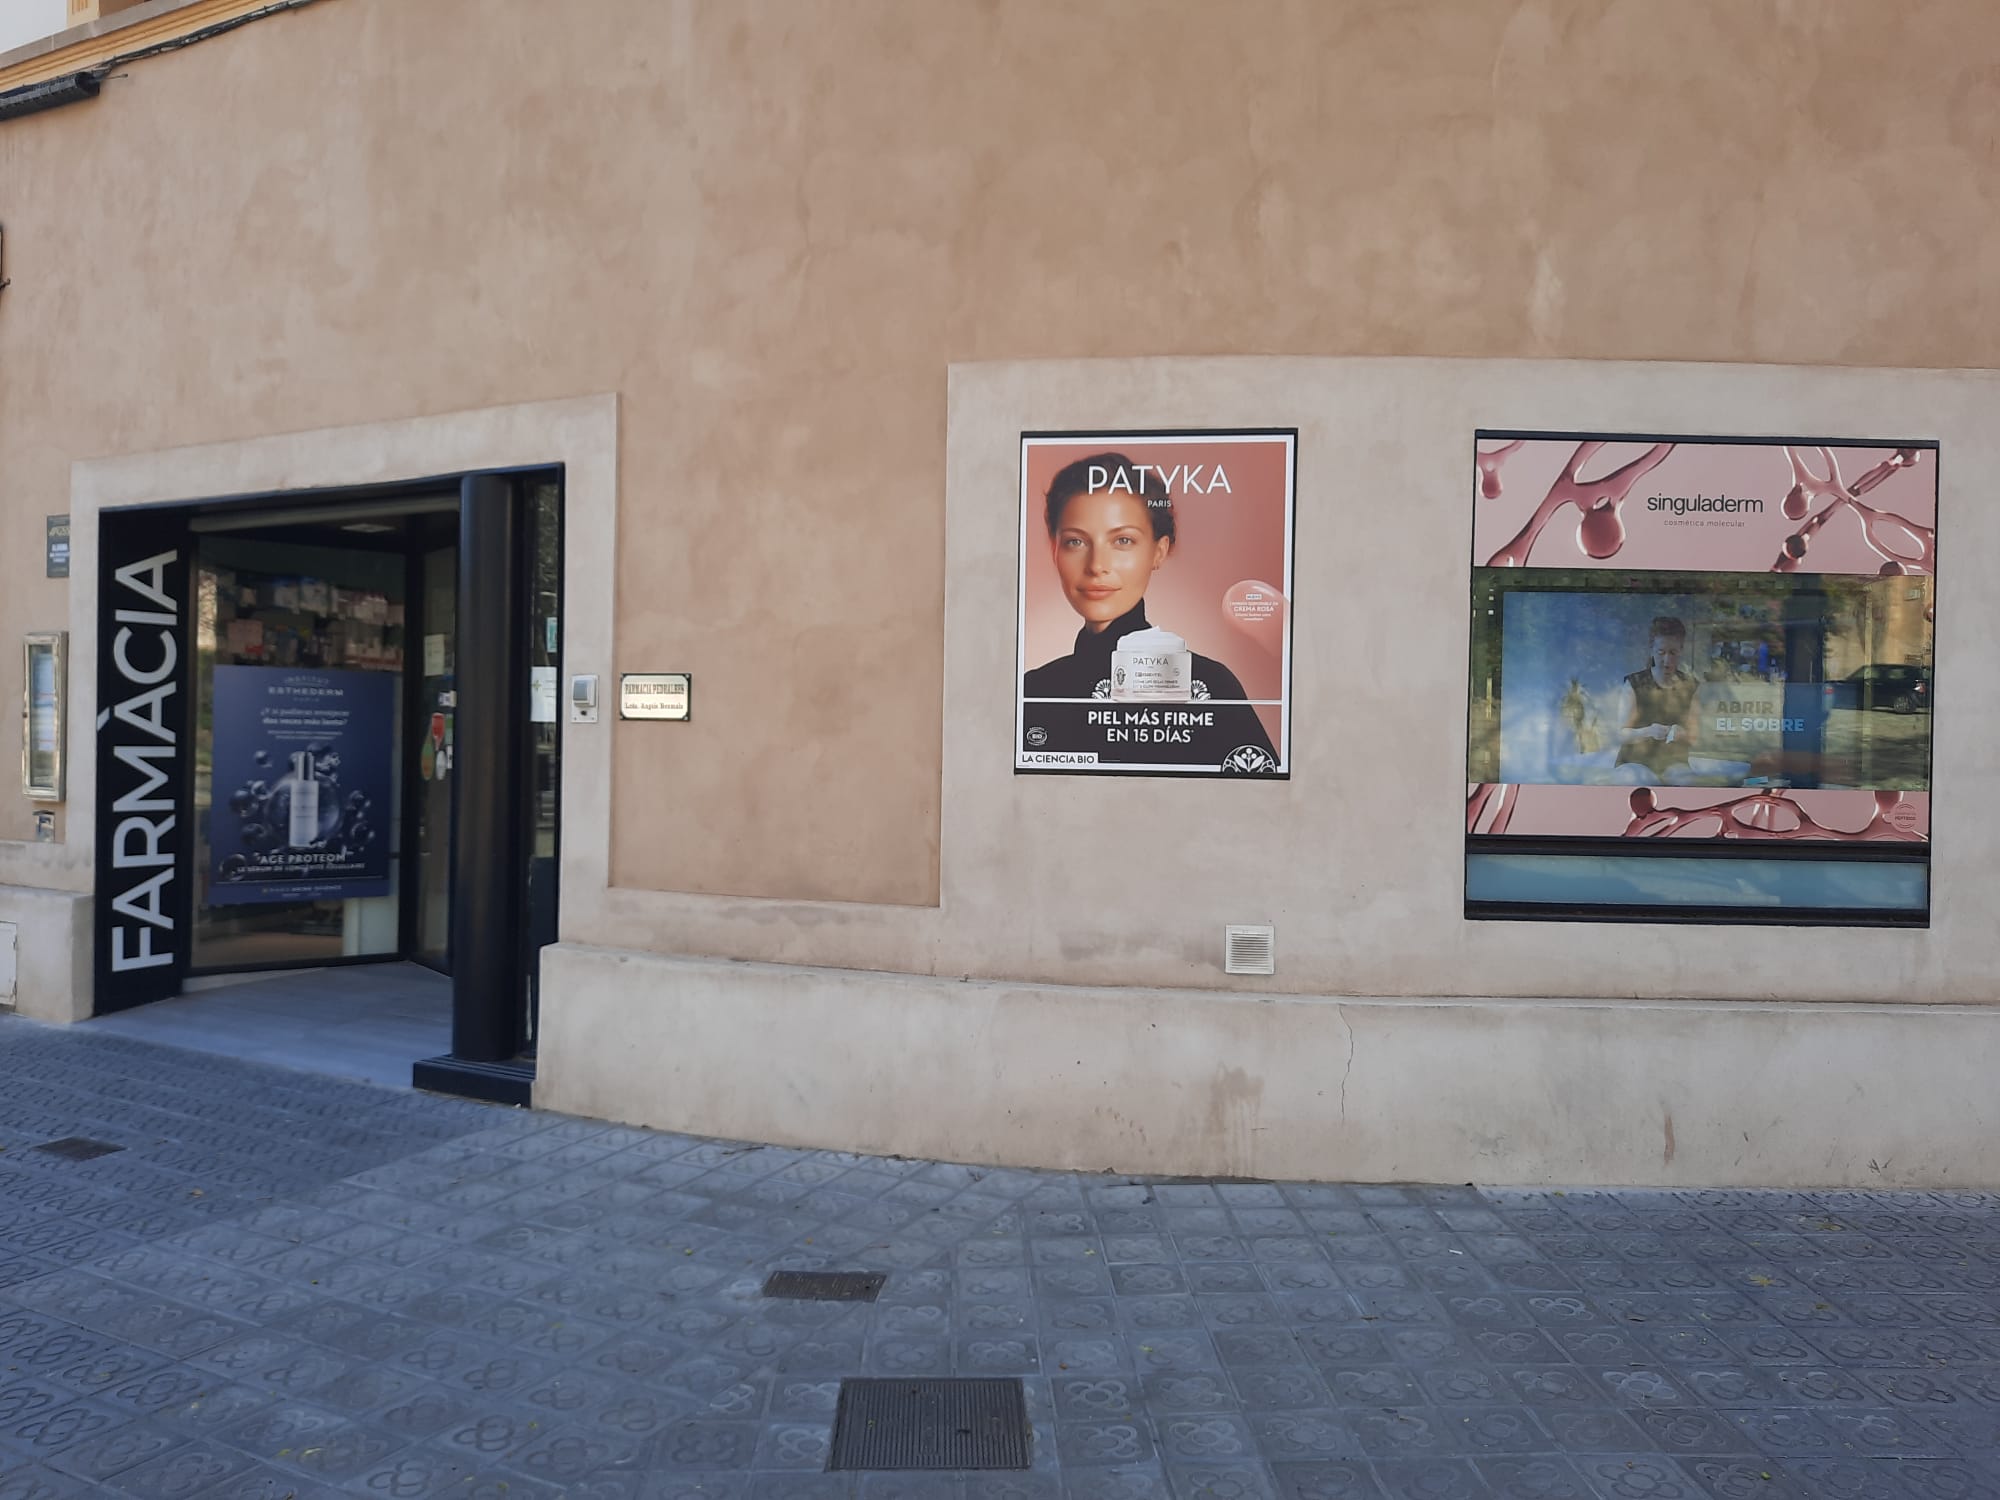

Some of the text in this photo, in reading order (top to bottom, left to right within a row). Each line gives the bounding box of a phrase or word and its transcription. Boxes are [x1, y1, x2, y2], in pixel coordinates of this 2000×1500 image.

[1087, 463, 1233, 496] PATYKA
[1147, 500, 1172, 508] PARIS
[1647, 492, 1764, 516] singuladerm
[1664, 519, 1745, 528] cosmética molecular
[1132, 657, 1169, 666] PATYKA
[268, 686, 344, 696] ESTHEDERM
[1716, 701, 1774, 714] ABRIR
[1088, 708, 1214, 726] PIEL MÁS FIRME
[1716, 718, 1805, 732] EL SOBRE
[1107, 728, 1129, 742] EN
[1133, 728, 1149, 742] 15
[96, 549, 178, 972] FARMÀCIA
[1022, 754, 1095, 764] LA CIENCIA BIO
[260, 854, 284, 864] AGE
